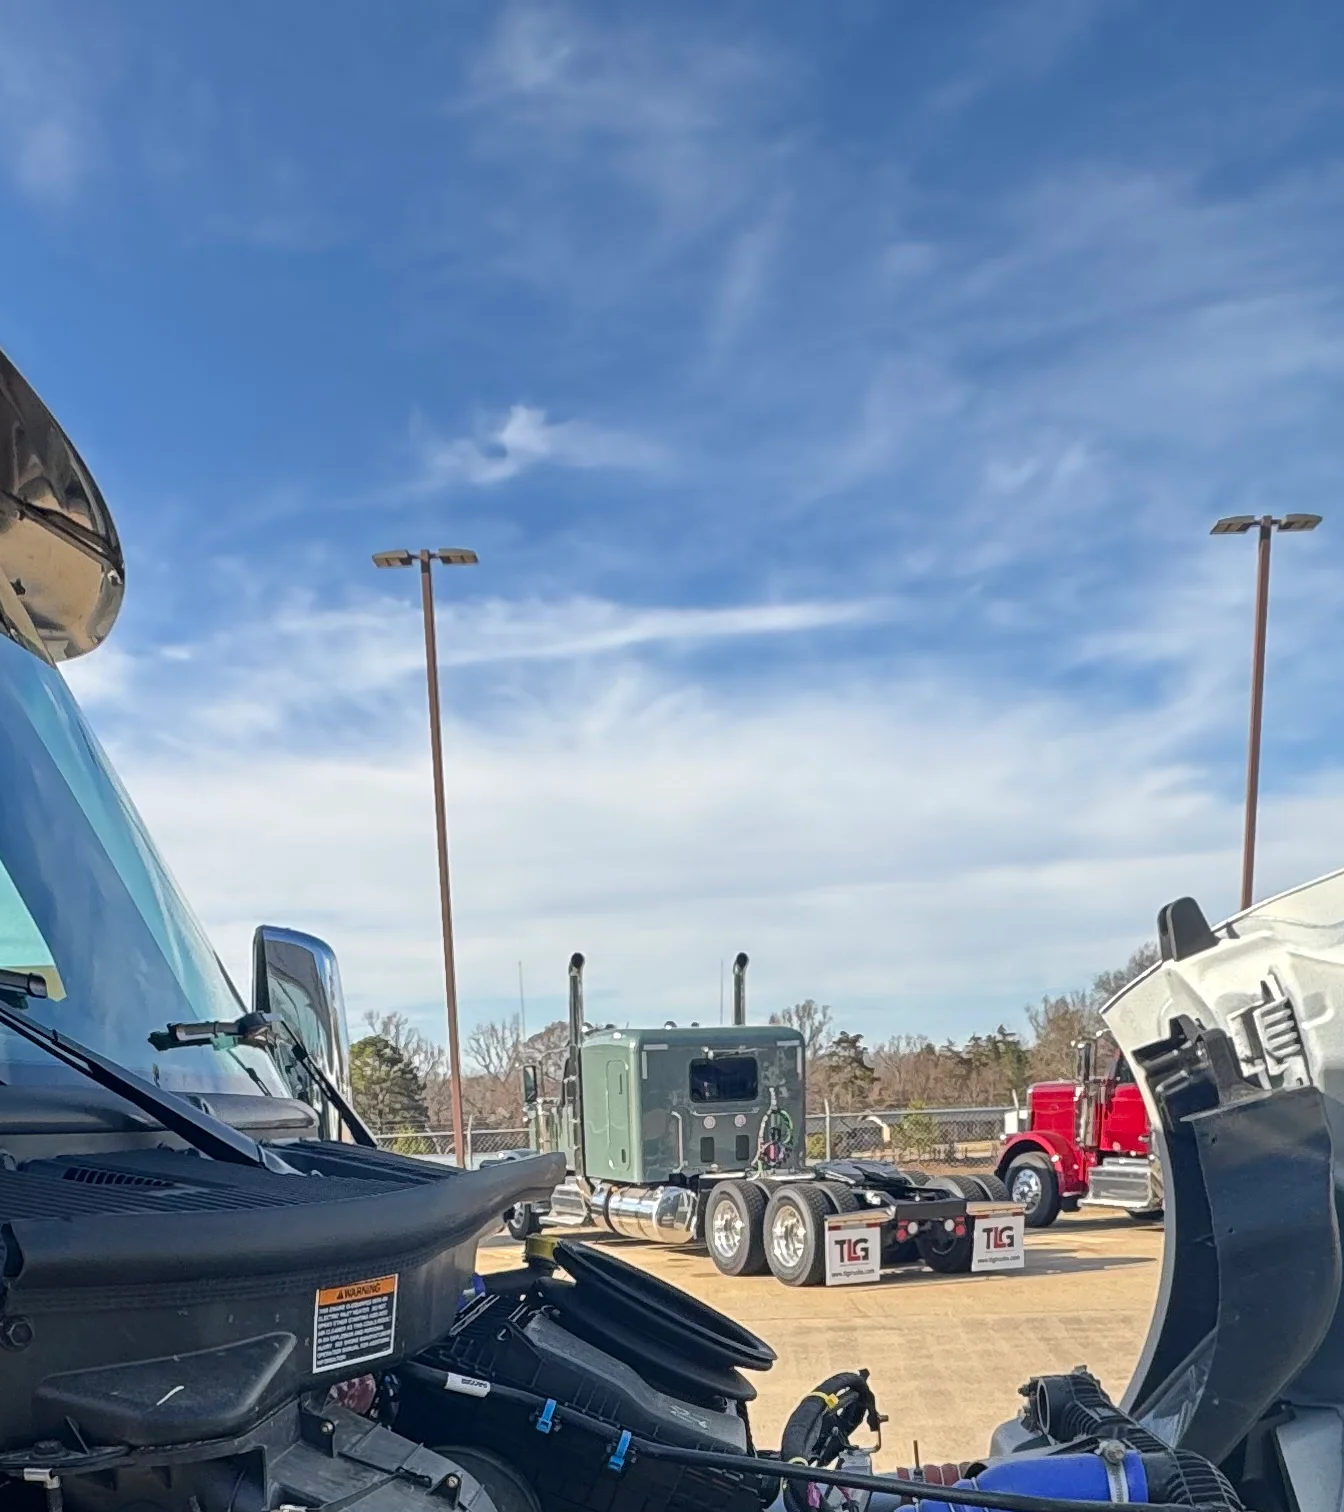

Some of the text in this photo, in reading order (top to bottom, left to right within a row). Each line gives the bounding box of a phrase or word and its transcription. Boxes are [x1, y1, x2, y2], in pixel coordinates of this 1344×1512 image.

[982, 1226, 1014, 1249] TLG
[834, 1238, 869, 1262] TLG
[345, 1283, 380, 1298] WARNING
